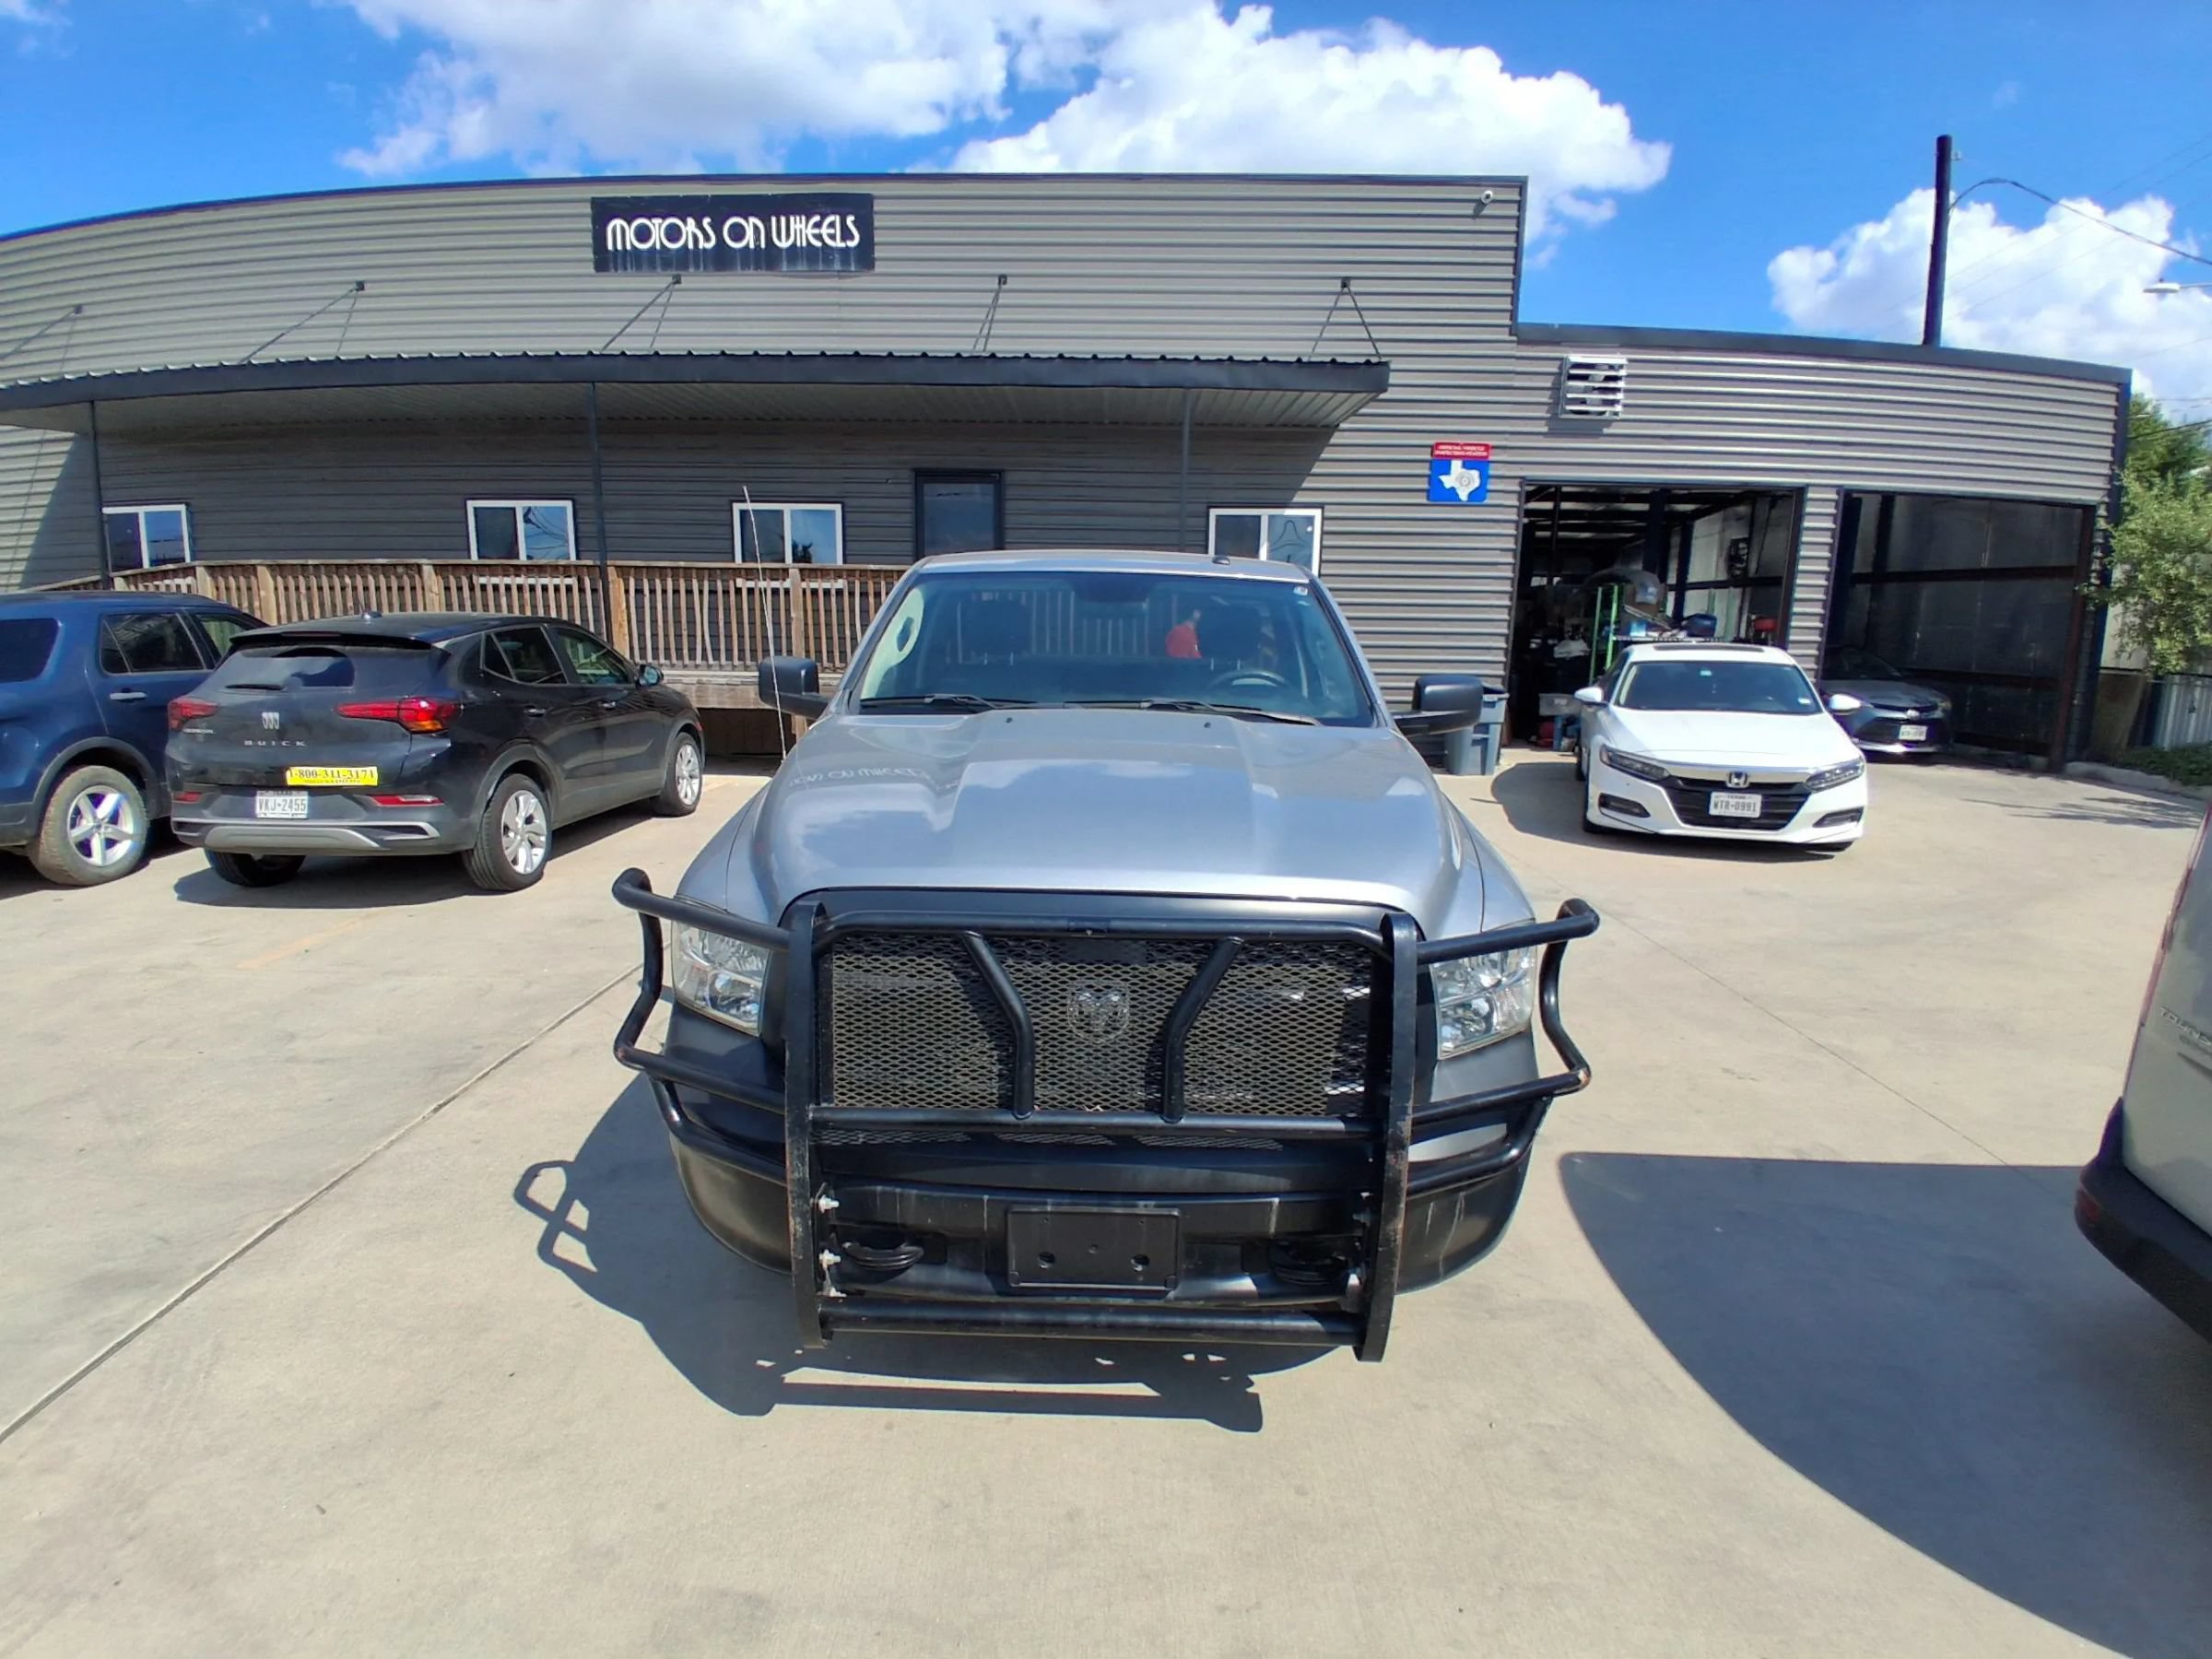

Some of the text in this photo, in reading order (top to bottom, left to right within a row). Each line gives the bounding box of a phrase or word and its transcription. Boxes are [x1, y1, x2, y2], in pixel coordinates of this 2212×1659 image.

[606, 214, 860, 251] MOTORS ON WHEELS
